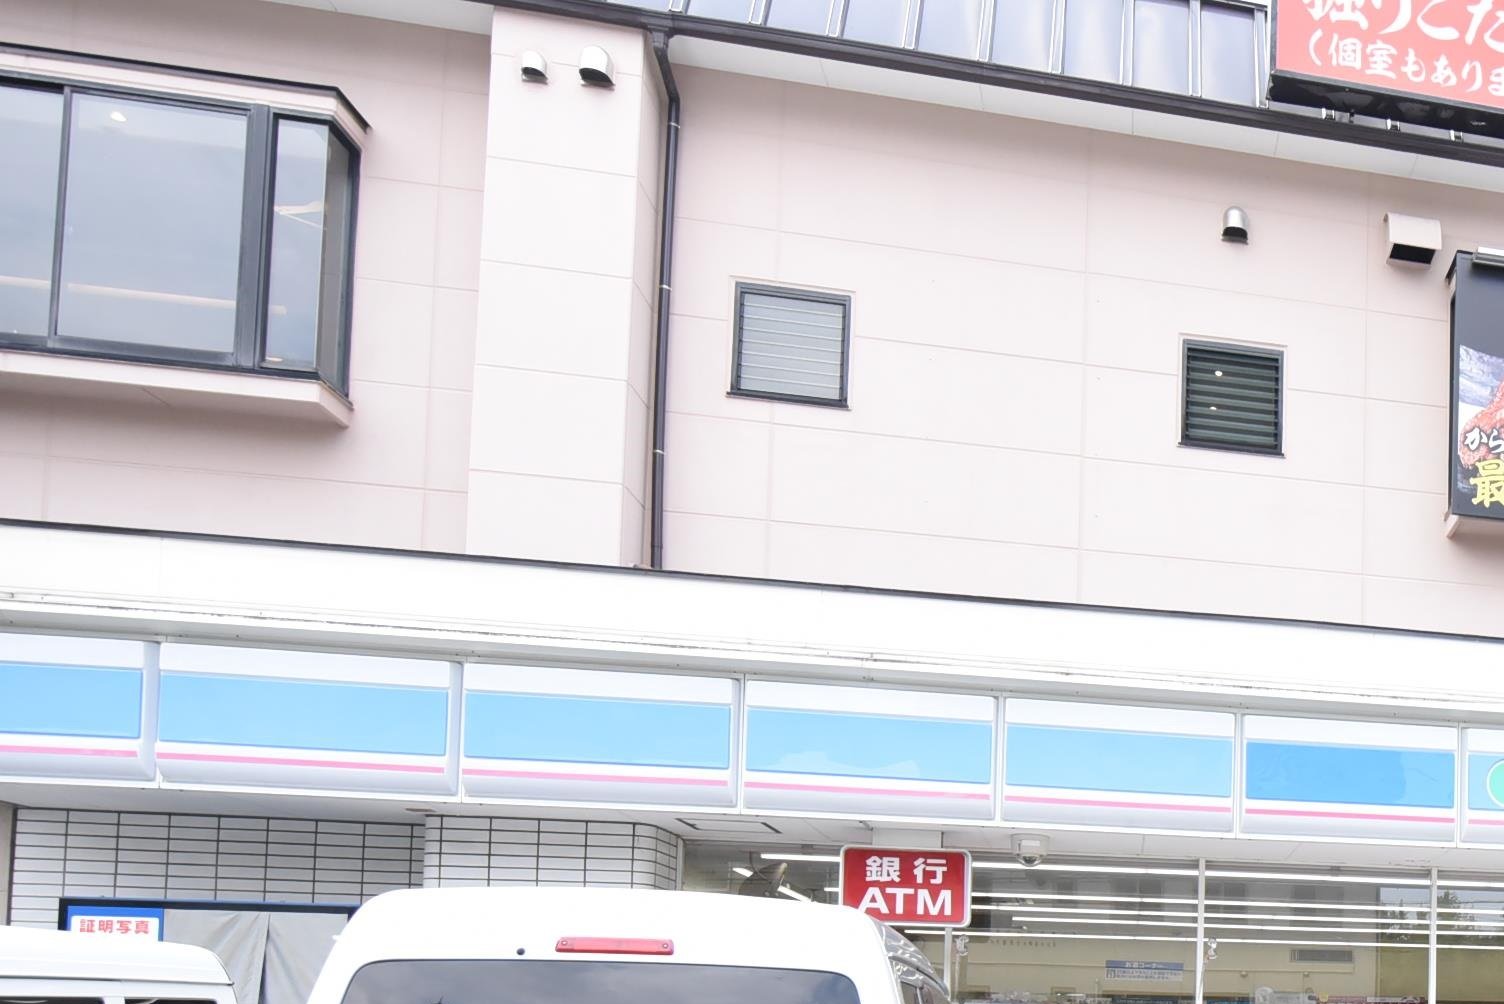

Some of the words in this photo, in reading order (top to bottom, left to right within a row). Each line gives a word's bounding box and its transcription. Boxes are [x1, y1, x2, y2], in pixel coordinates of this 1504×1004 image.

[865, 855, 948, 885] 銀行
[858, 886, 952, 916] ATM
[79, 918, 150, 935] 証明写真
